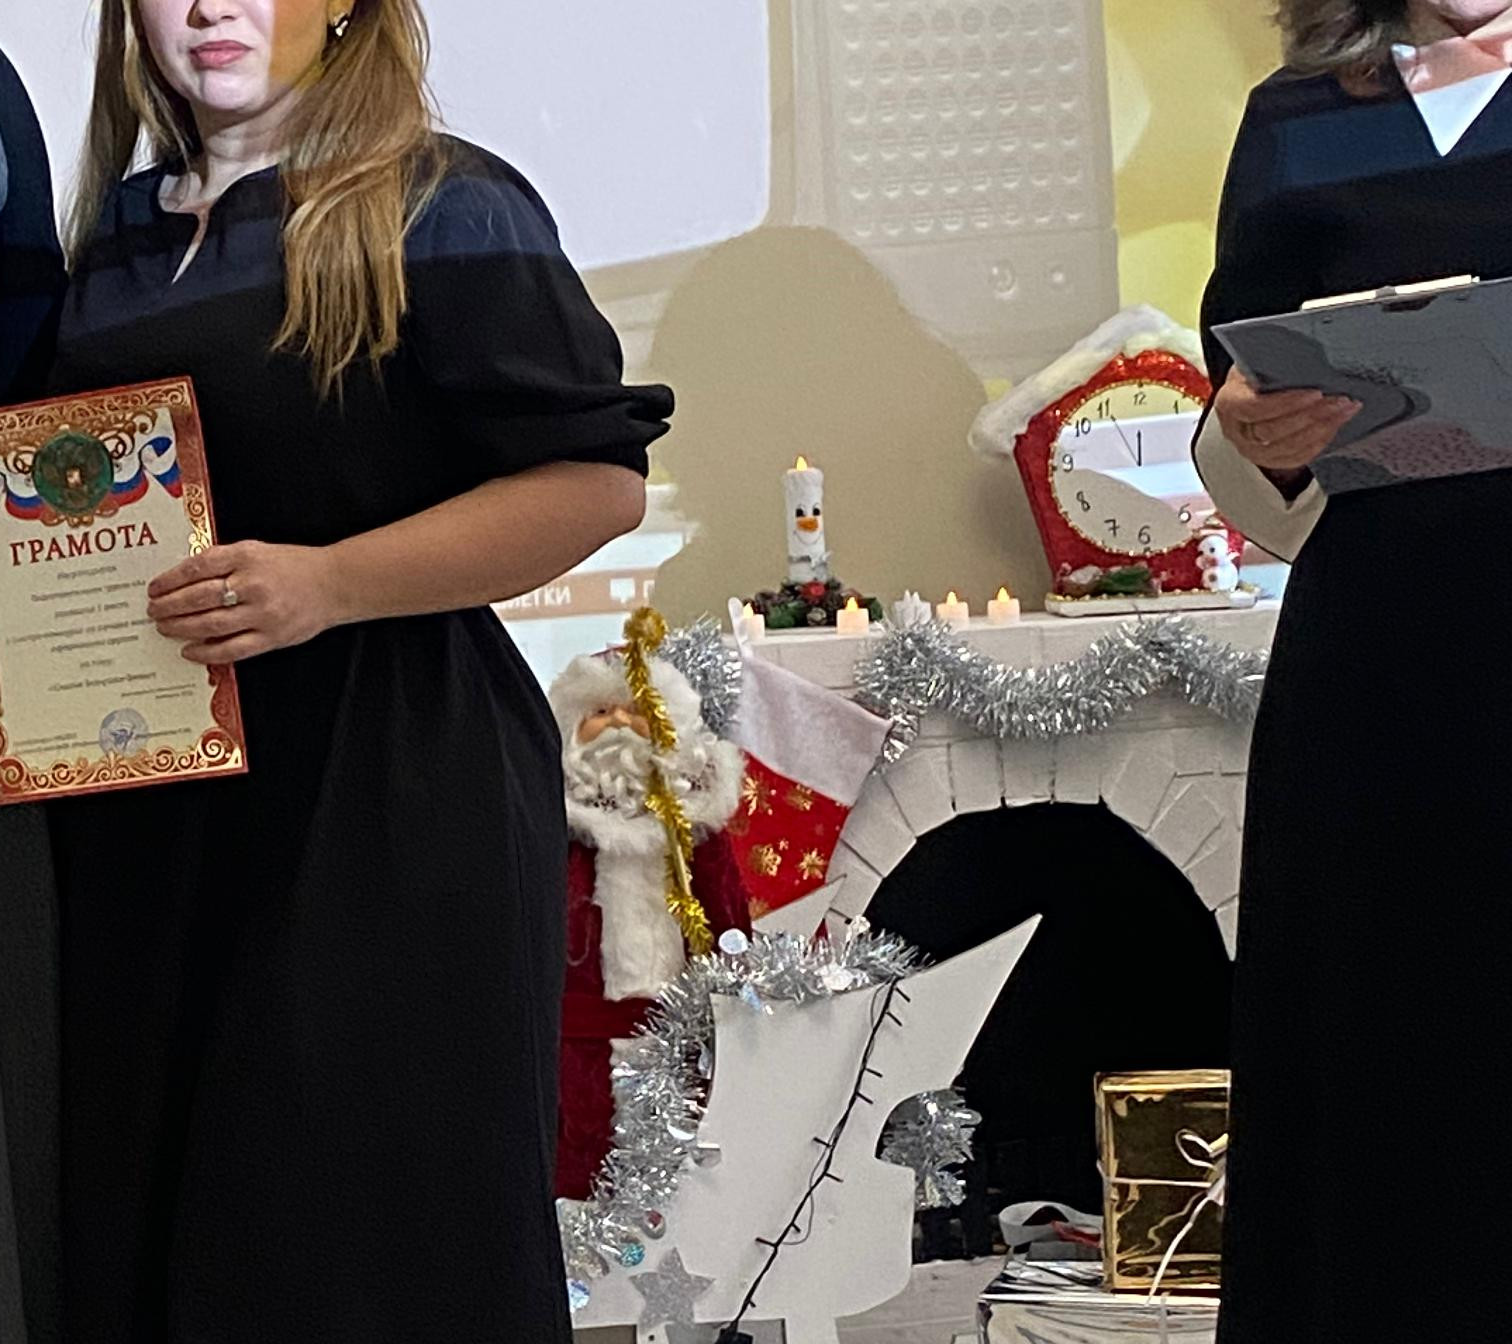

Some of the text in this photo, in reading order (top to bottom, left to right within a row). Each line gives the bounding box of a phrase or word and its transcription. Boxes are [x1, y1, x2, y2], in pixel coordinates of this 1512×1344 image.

[1096, 397, 1112, 420] 11
[1133, 391, 1147, 406] 12
[1173, 399, 1180, 415] 1
[1074, 417, 1092, 438] 10
[1062, 454, 1074, 473] 9
[1076, 491, 1091, 512] 8
[1104, 518, 1121, 537] 7
[1138, 525, 1152, 545] 6
[9, 522, 158, 567] ГРАМОТА
